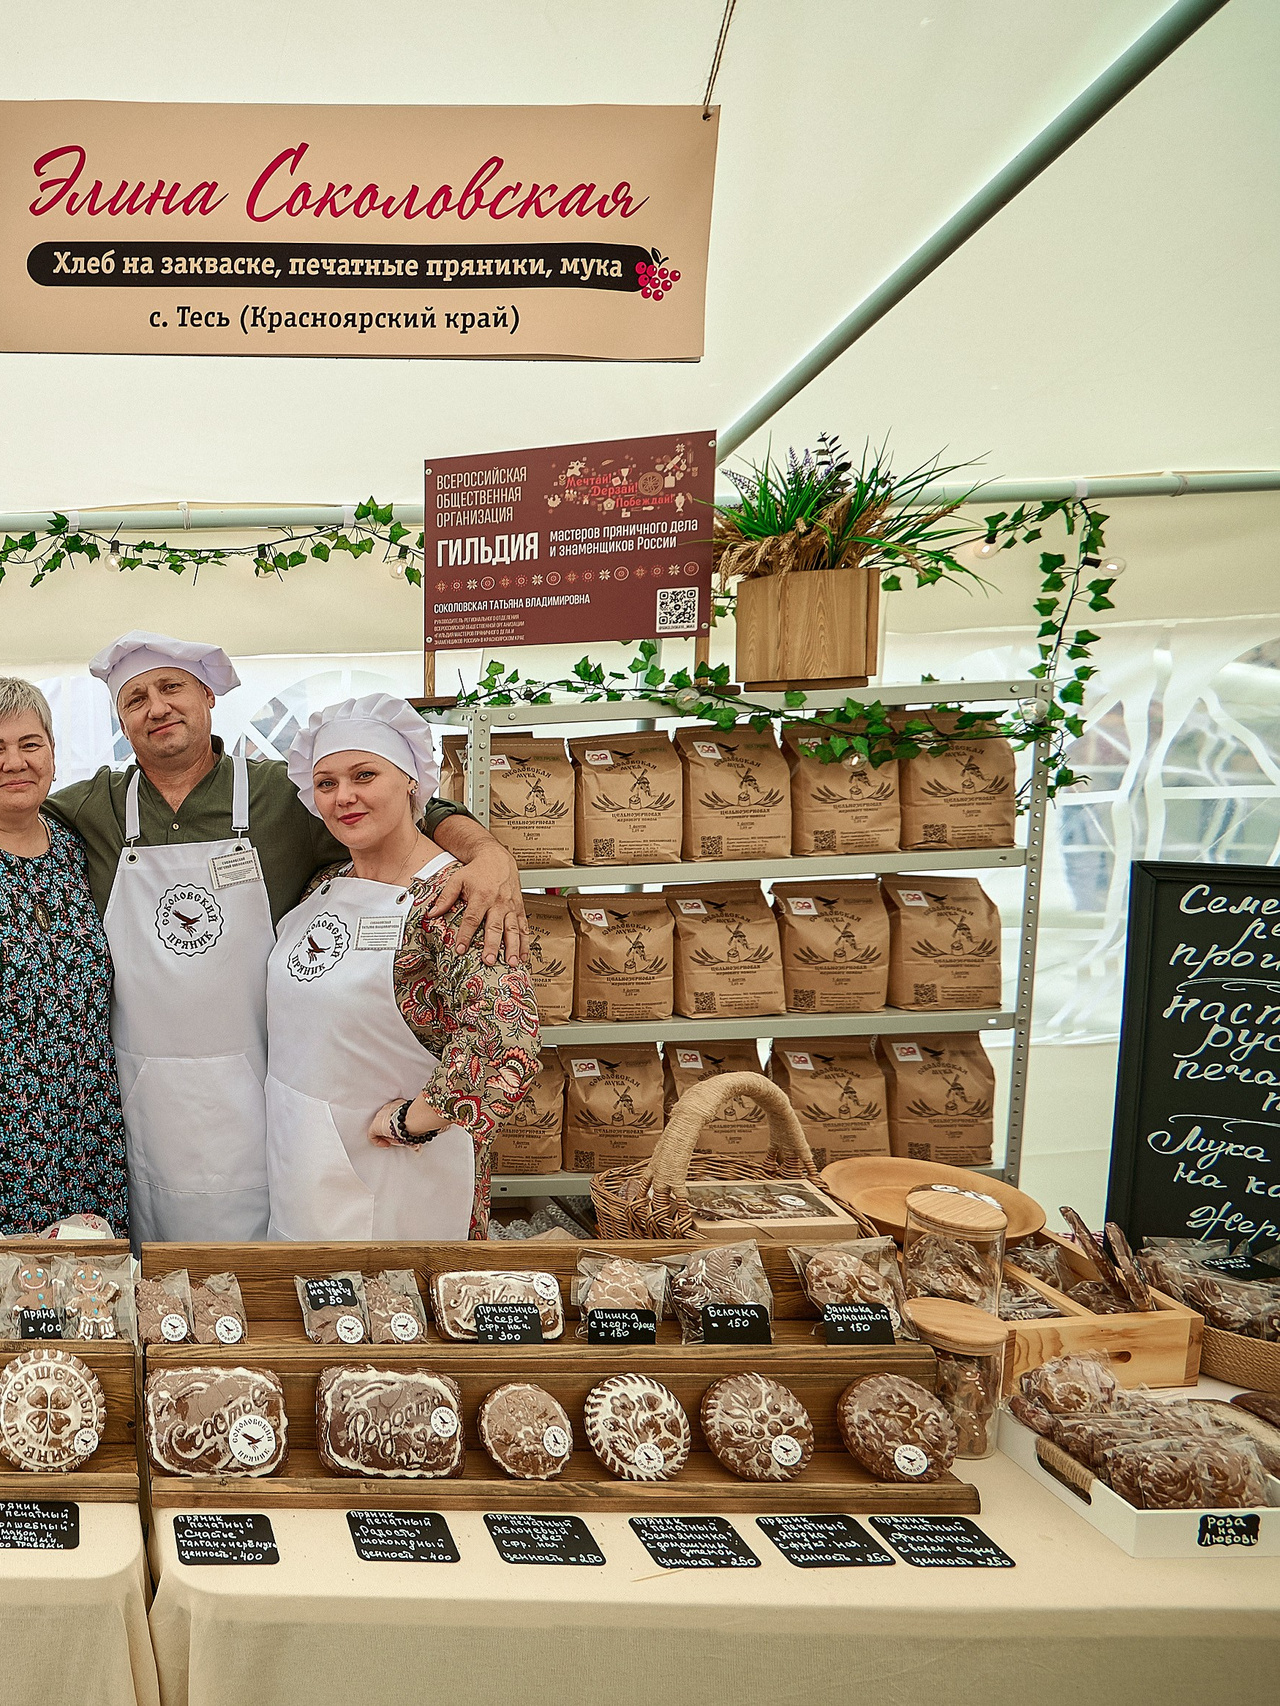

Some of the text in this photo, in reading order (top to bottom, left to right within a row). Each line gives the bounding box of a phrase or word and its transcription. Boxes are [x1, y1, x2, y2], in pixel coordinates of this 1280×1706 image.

[29, 142, 650, 222] Элина Соколовская
[52, 250, 623, 284] Хлеб на закваске, печатные пряники, мука
[149, 305, 520, 334] с. Тесь (Красноярский край)
[436, 467, 526, 490] ВСЕРОССИЙСКАЯ
[437, 487, 521, 509] ОБЩЕСТВЕННАЯ
[437, 506, 513, 528] ОРГАНИЗАЦИЯ
[550, 519, 698, 542] мастеров пряничного дела
[438, 532, 538, 567] ГИЛЬДИЯ
[550, 536, 676, 557] и знаменщиков России
[433, 594, 590, 614] СОКОЛОВСКАЯ ТАТЬЯНА ВЛАДИМИРОВНА
[162, 892, 218, 925] СОКОЛОВСКИЙ
[167, 931, 213, 949] ПРЯНИК
[1147, 1125, 1271, 1169] Мука
[1173, 1162, 1227, 1188] на
[307, 1280, 343, 1289] Клевер
[329, 1296, 342, 1304] 50
[594, 1311, 639, 1321] Шишка
[707, 1306, 759, 1318] Белочка
[40, 1322, 61, 1333] 100
[728, 1318, 749, 1328] 150
[850, 1324, 870, 1332] 150
[499, 1331, 520, 1340] 300
[611, 1329, 629, 1337] 150
[6, 1509, 68, 1519] печатный
[190, 1519, 253, 1529] печатный
[366, 1518, 431, 1526] печатный
[650, 1522, 718, 1532] печатный
[782, 1521, 847, 1531] печатный
[893, 1522, 965, 1531] печатный
[1208, 1517, 1246, 1528] Роза
[1218, 1527, 1236, 1535] на
[1202, 1533, 1258, 1545] Любовь
[16, 1541, 64, 1549] травами
[360, 1539, 444, 1550] шоколадный
[657, 1542, 728, 1552] домашним
[182, 1550, 263, 1560] ценность 400
[361, 1549, 451, 1560] ценность 400
[503, 1552, 563, 1561] ценность
[791, 1553, 851, 1562] ценность
[731, 1557, 756, 1566] 250
